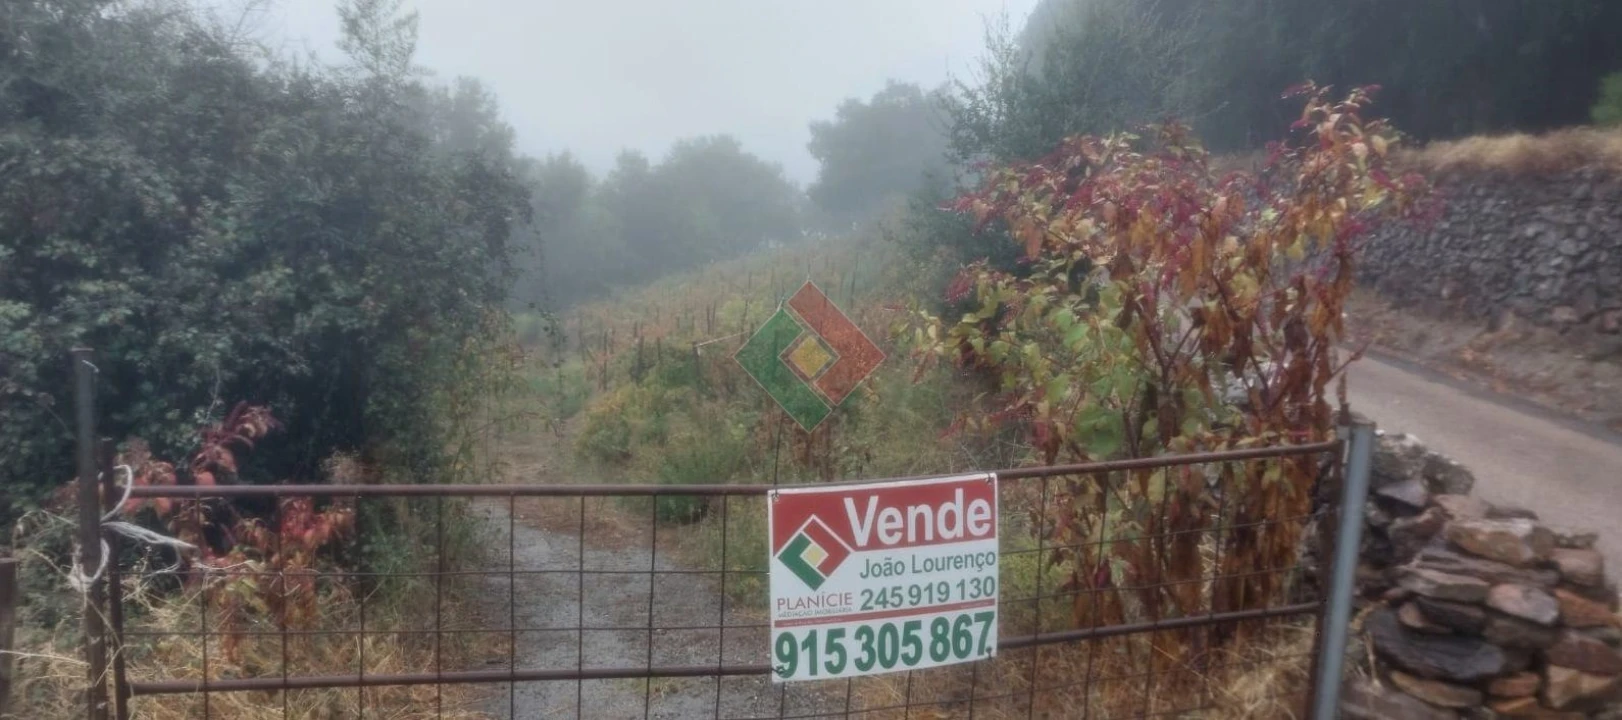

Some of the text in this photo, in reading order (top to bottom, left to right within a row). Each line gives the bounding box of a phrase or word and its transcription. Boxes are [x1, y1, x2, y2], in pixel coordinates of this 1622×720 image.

[843, 488, 992, 547] Vende
[860, 551, 996, 579] João Lourenço
[777, 591, 853, 610] PLANÍCIE
[860, 576, 996, 611] 245 919 130
[775, 611, 995, 679] 915 305 867
